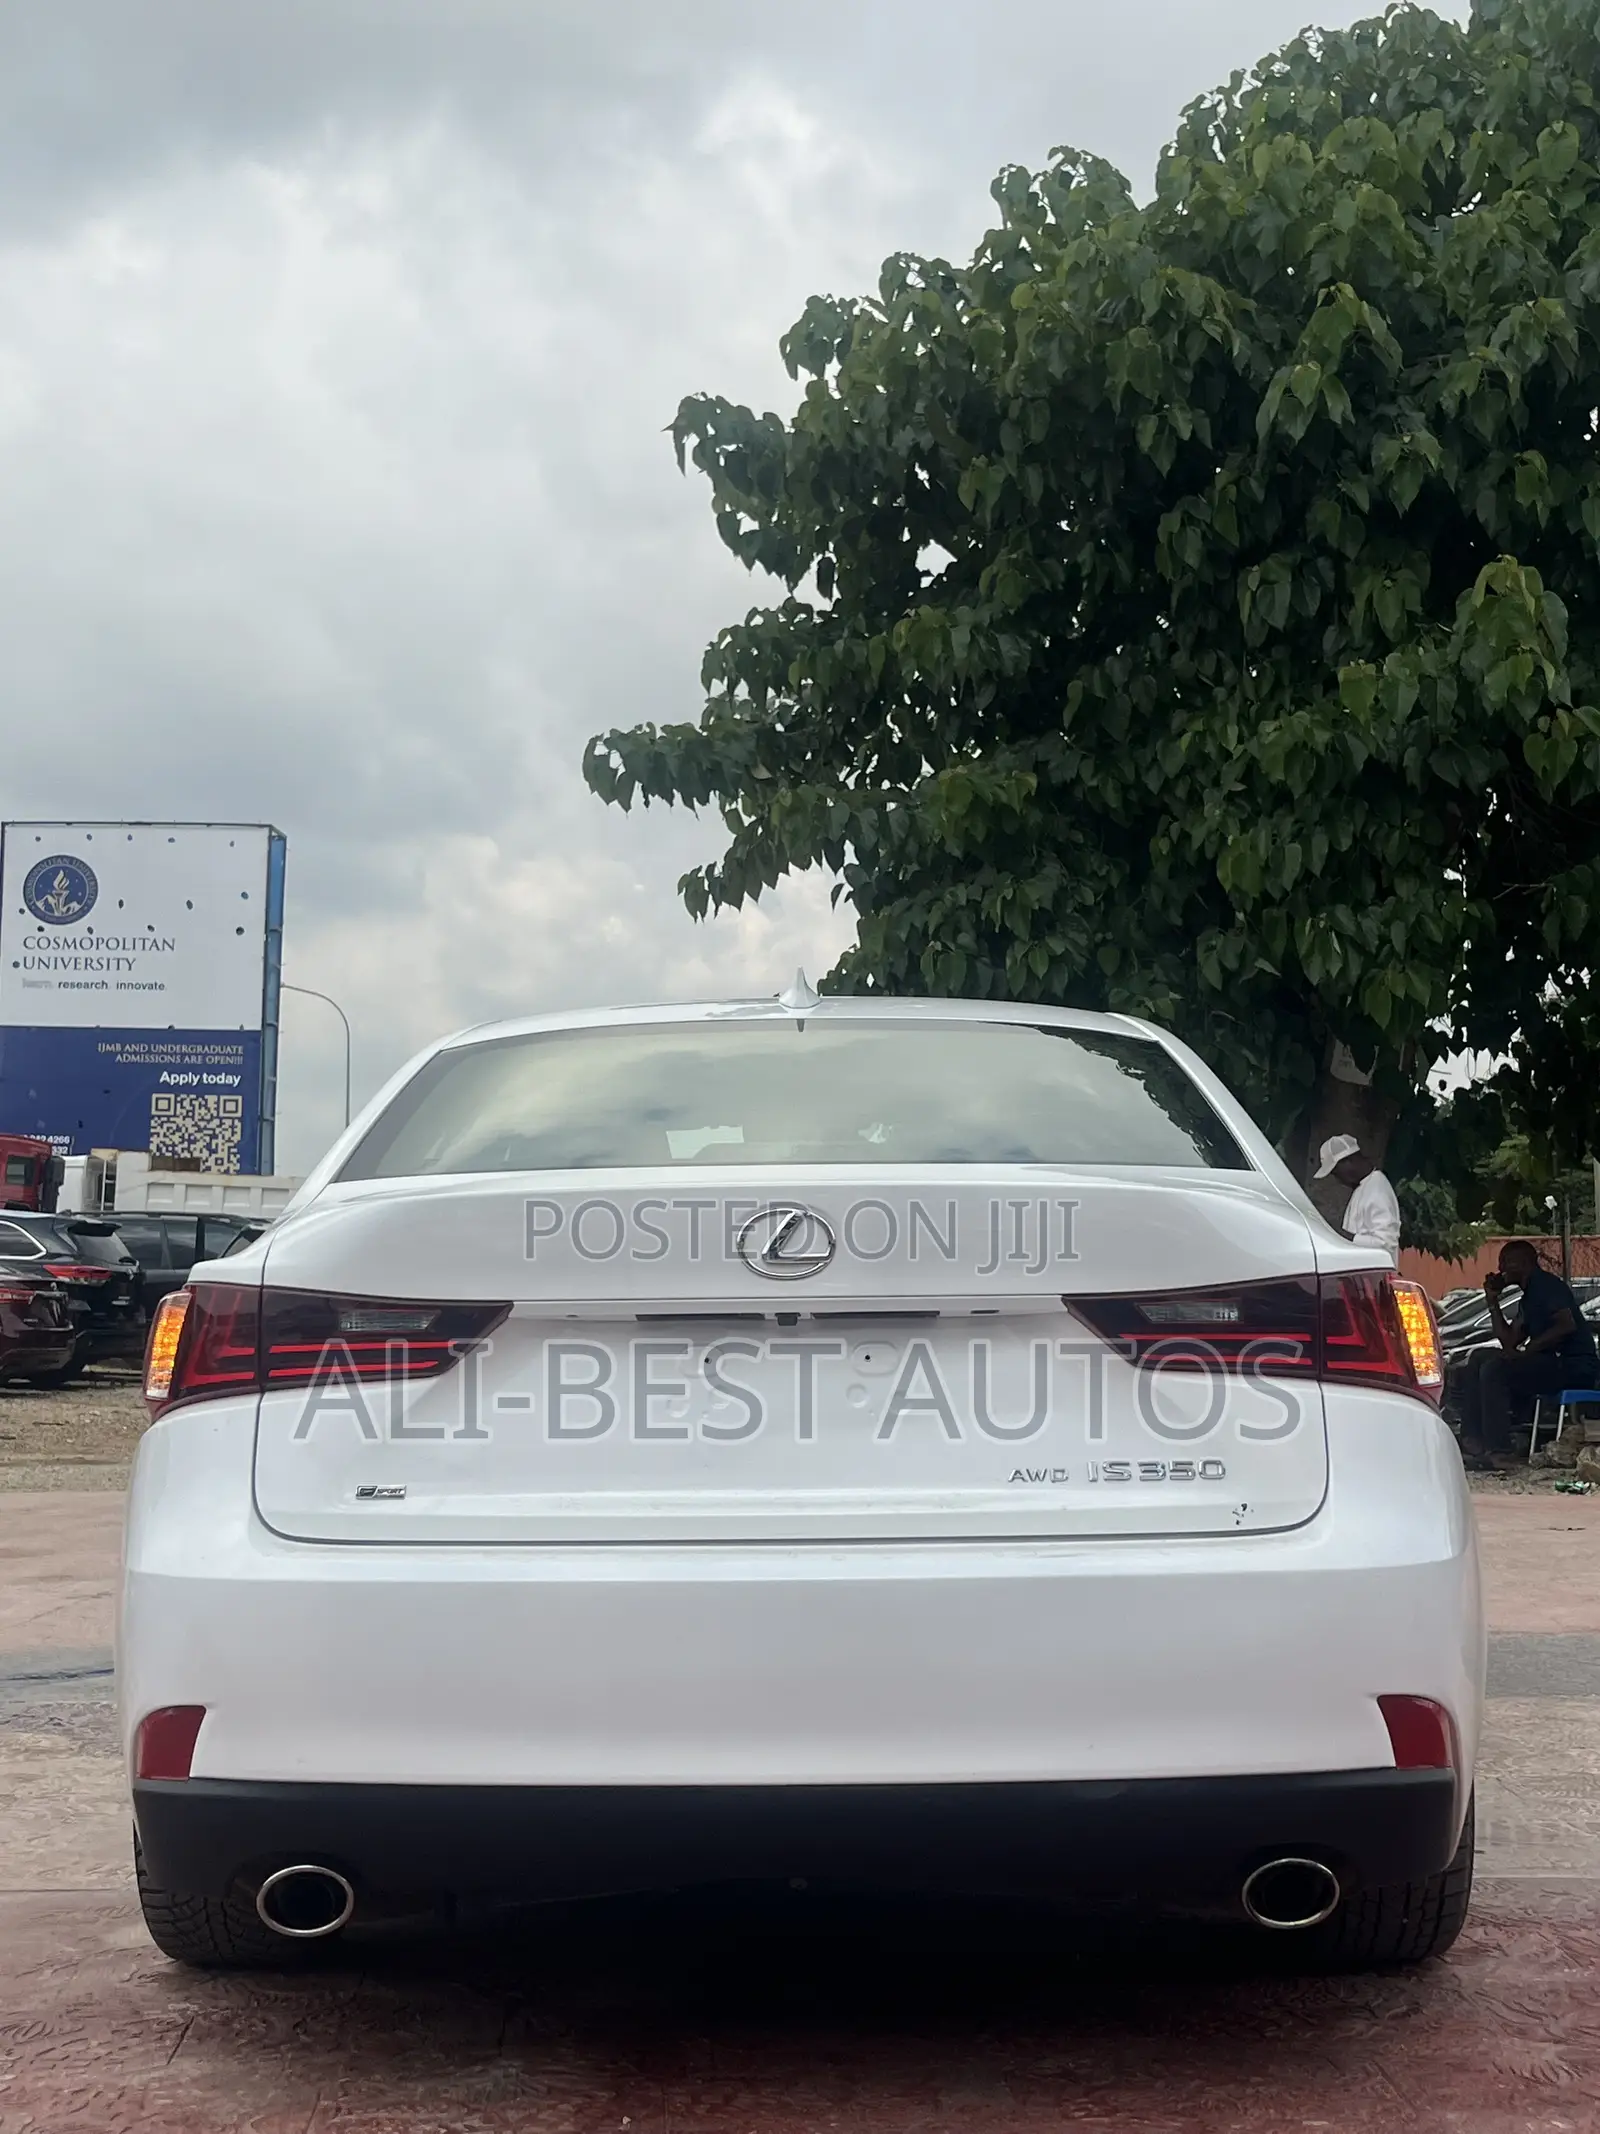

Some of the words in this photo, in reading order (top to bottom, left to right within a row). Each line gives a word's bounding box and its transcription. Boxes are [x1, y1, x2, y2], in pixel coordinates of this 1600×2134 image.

[23, 936, 176, 952] COSMOPOLITAN
[23, 956, 137, 972] UNIVERSITY
[57, 979, 109, 990] research
[116, 980, 166, 991] innovate
[124, 1043, 149, 1053] AND
[150, 1044, 244, 1055] UNDERGRADUATE
[114, 1053, 181, 1064] ADMISSIONS
[183, 1055, 203, 1065] ARE
[159, 1070, 201, 1087] Apply
[202, 1072, 242, 1088] today
[1007, 1467, 1070, 1484] AWD
